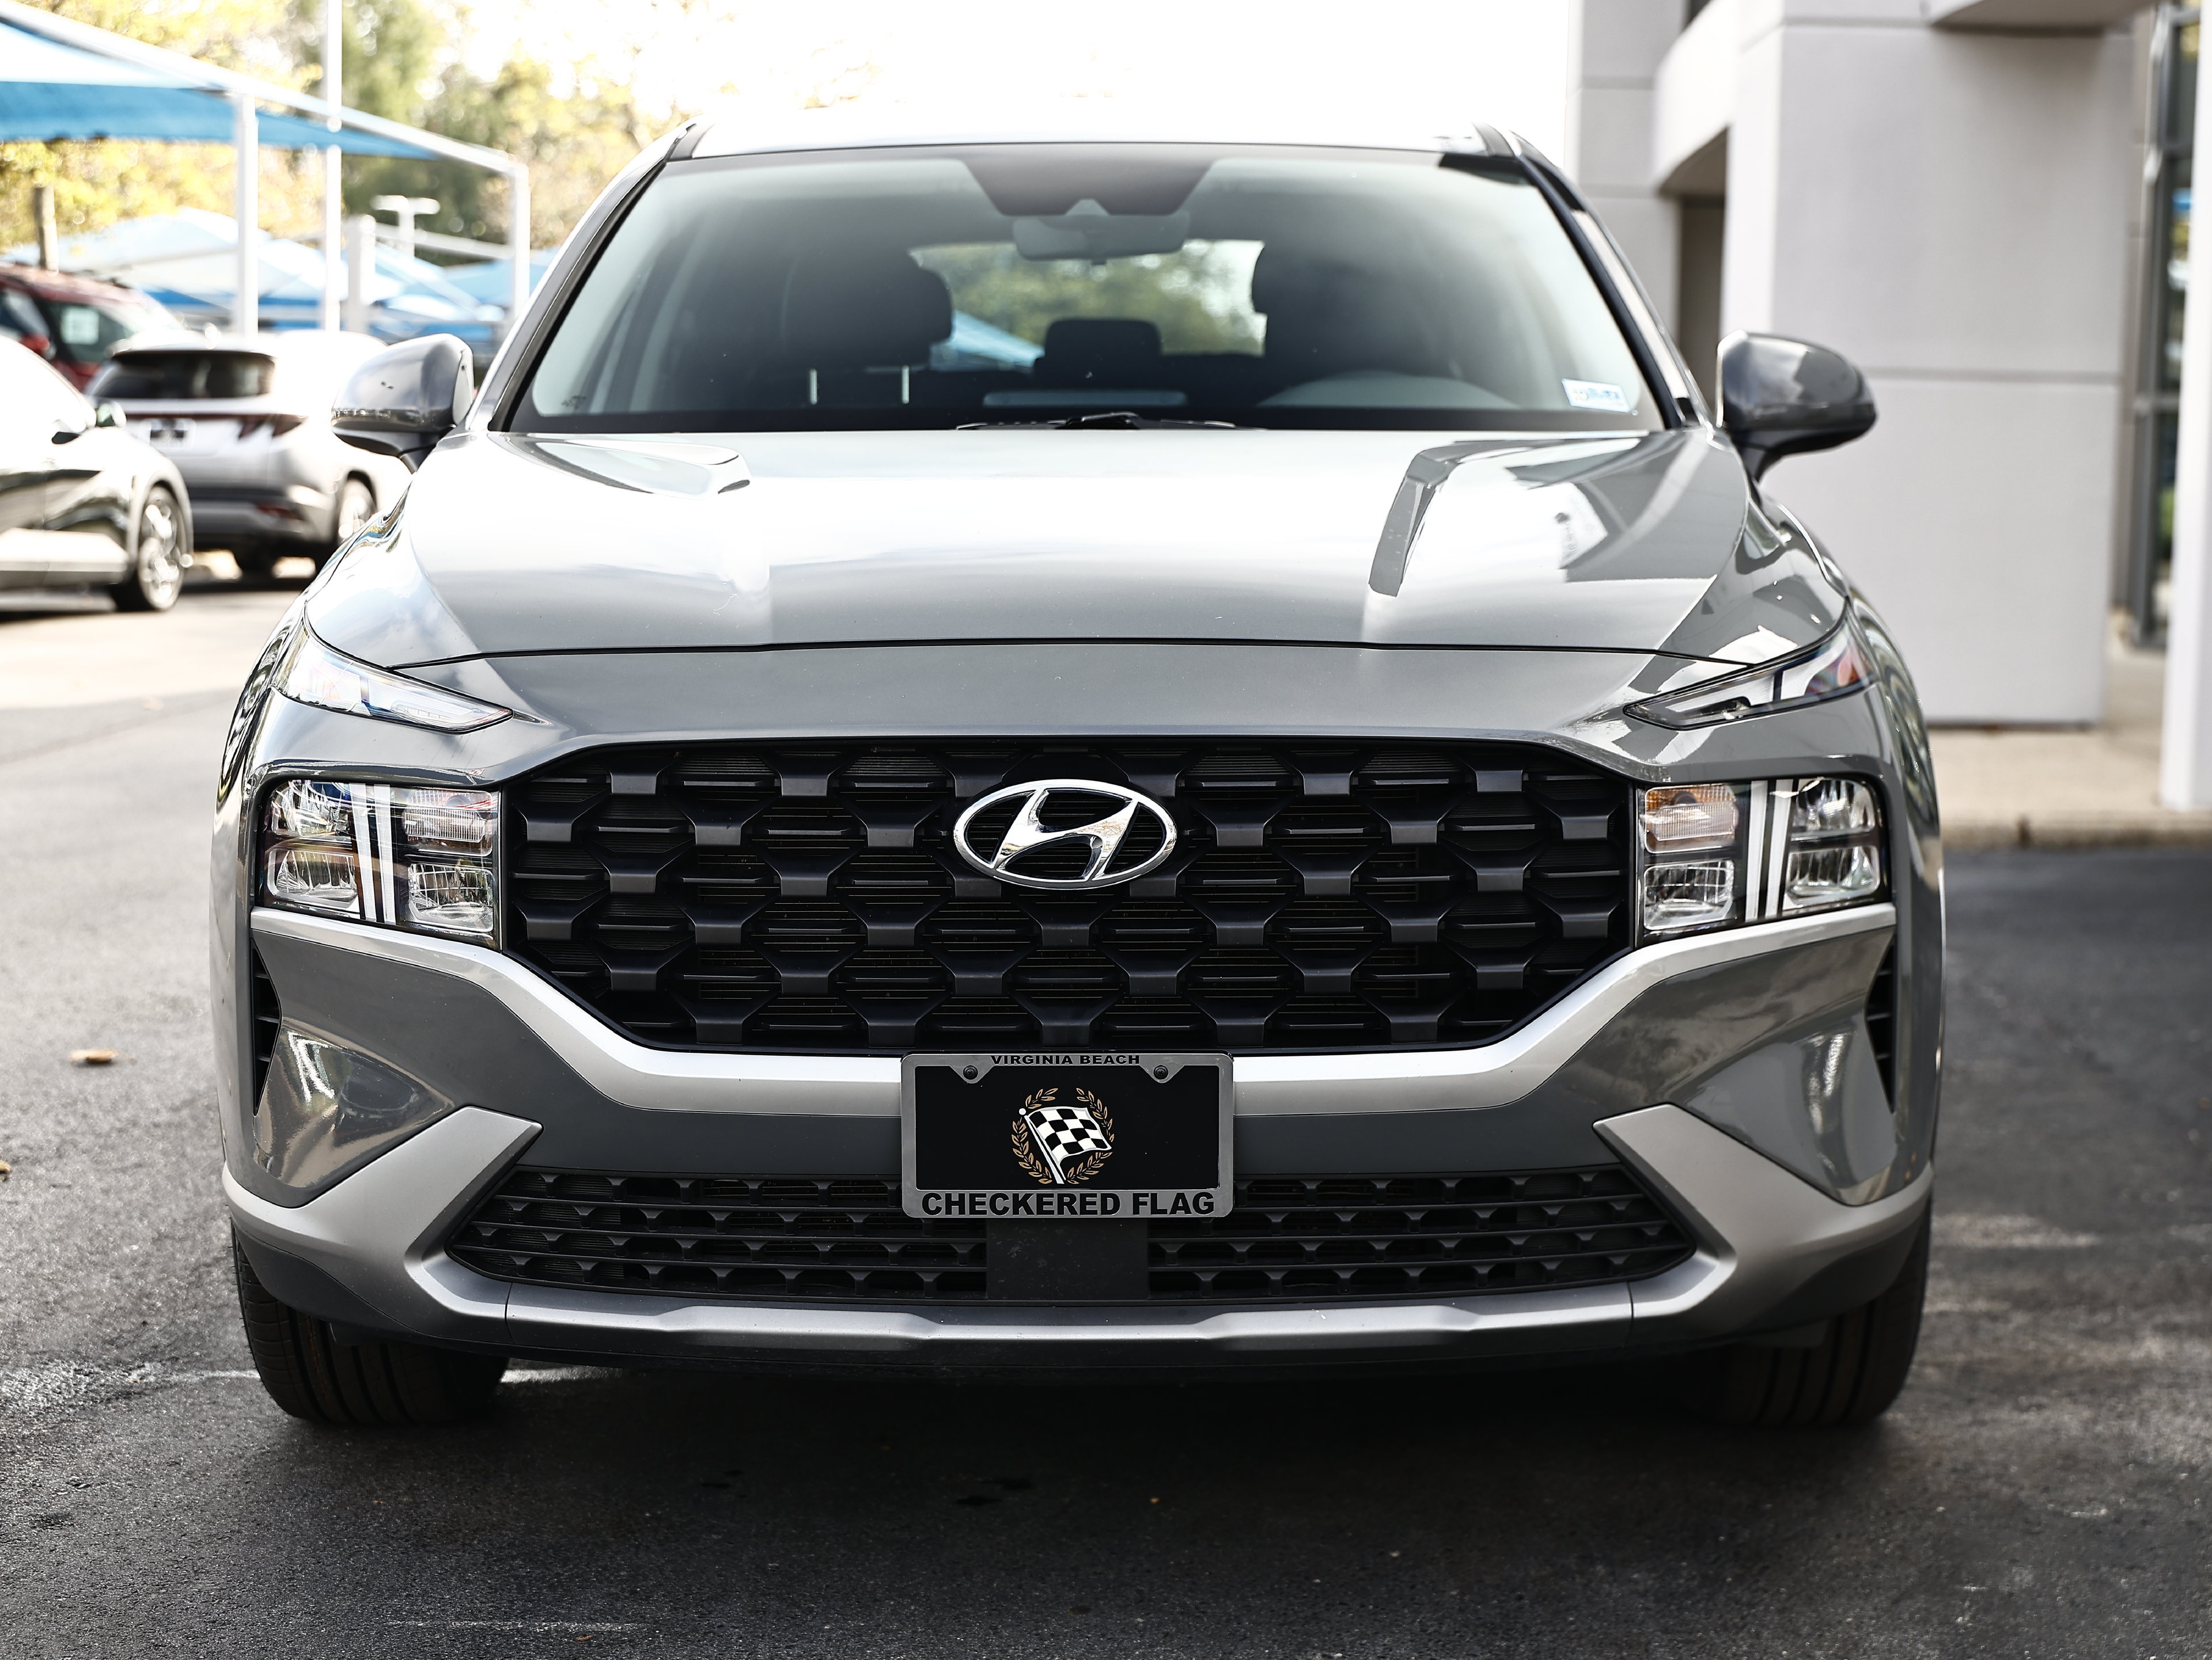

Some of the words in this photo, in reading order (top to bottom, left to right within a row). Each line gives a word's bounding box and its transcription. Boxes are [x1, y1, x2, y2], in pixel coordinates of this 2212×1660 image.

[990, 1055, 1073, 1065] VIRGINIA
[1080, 1055, 1140, 1065] BEACH
[921, 1192, 1121, 1216] CHECKERED
[1132, 1191, 1215, 1216] FLAG
